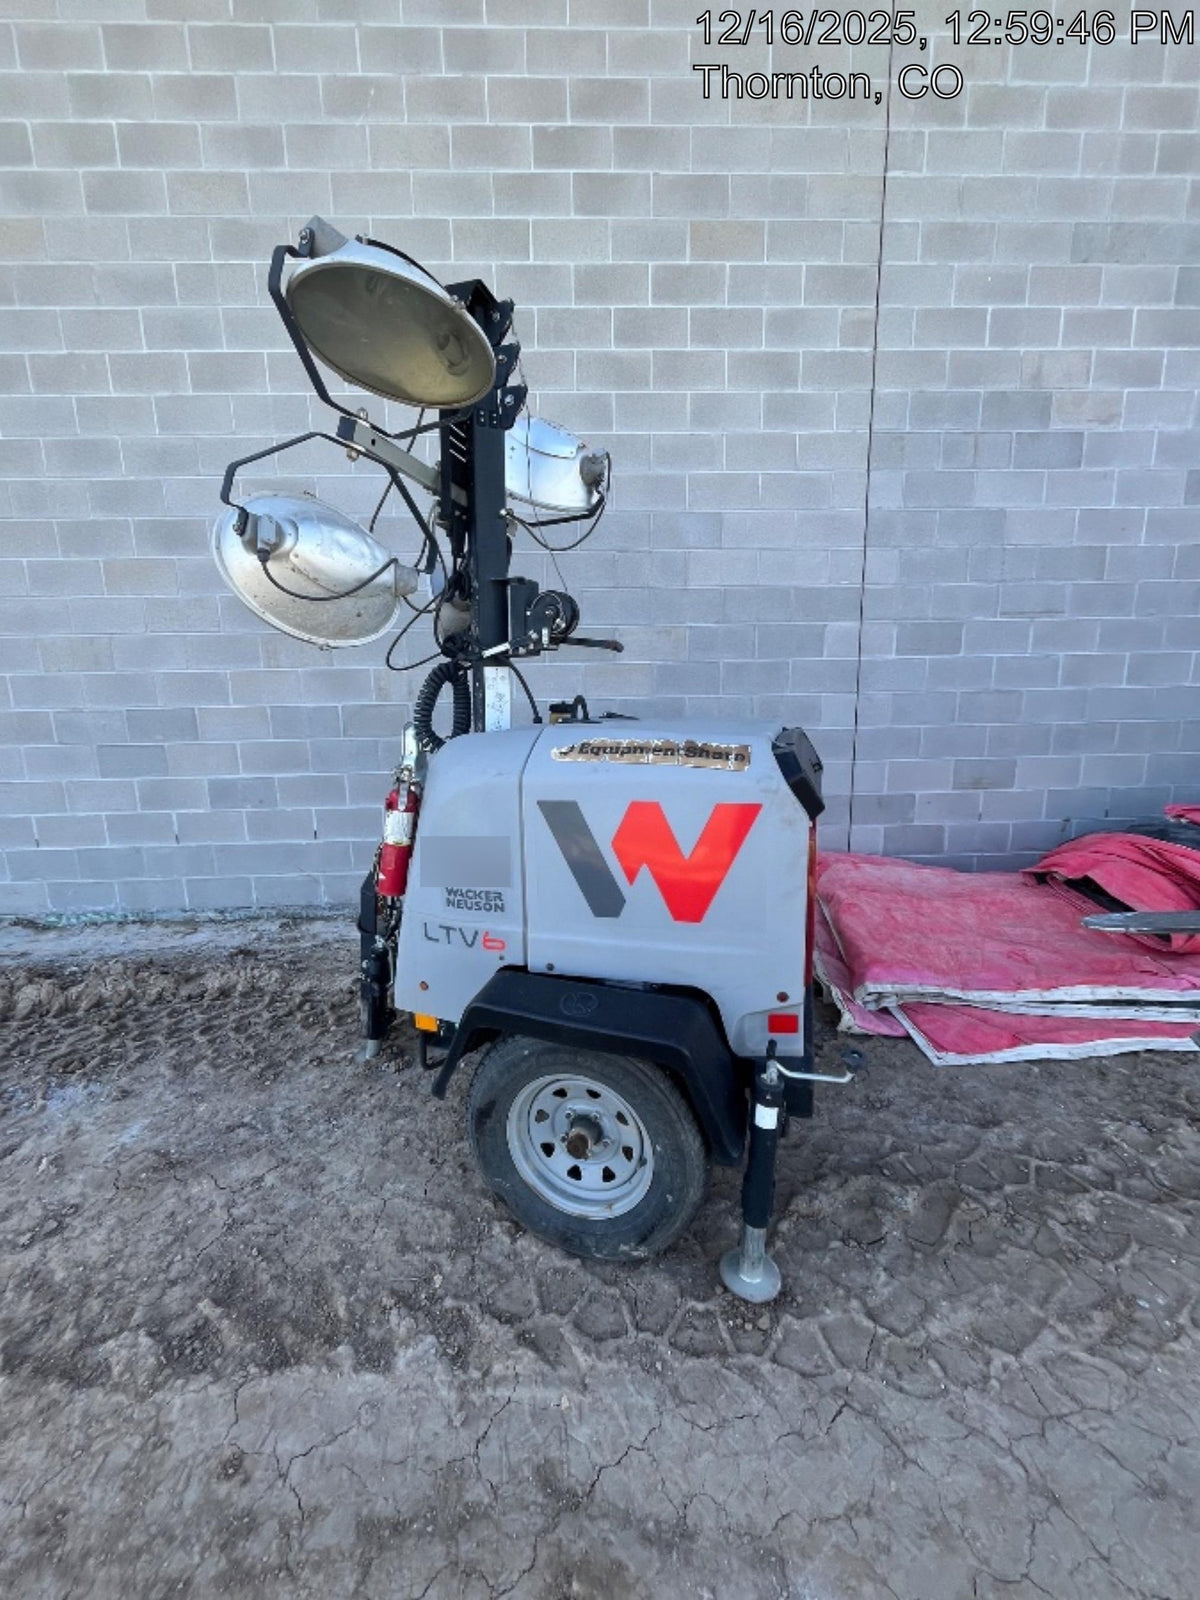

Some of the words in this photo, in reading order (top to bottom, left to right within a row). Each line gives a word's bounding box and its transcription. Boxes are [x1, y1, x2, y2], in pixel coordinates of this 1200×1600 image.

[445, 887, 504, 902] WACKER
[445, 898, 505, 913] NEUSON
[423, 922, 506, 951] LTV6
